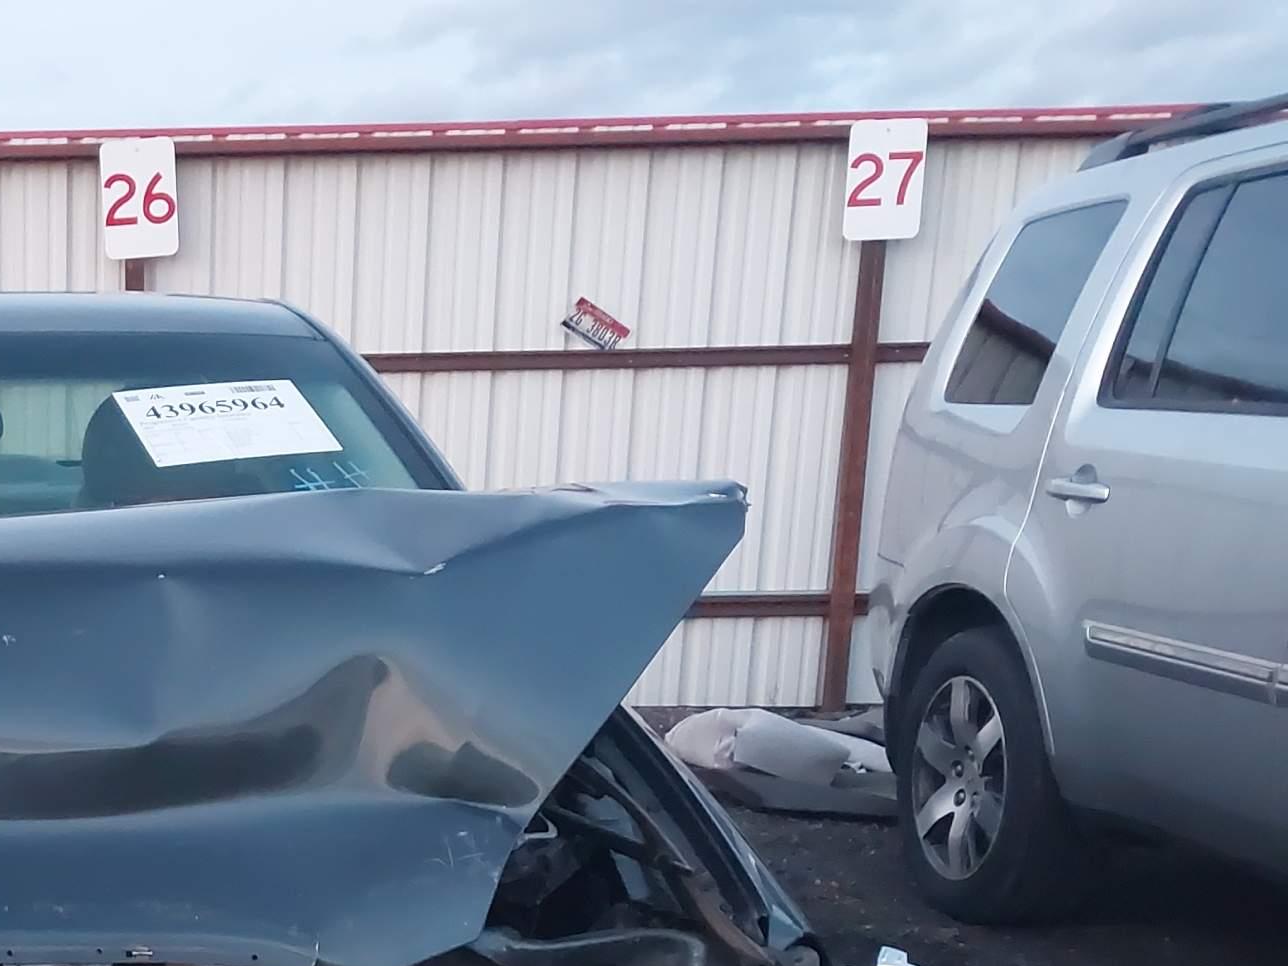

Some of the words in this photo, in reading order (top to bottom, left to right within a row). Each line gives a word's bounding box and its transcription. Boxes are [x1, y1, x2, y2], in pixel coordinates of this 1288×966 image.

[103, 172, 176, 228] 26
[846, 151, 925, 208] 27
[145, 396, 285, 419] 43965964
